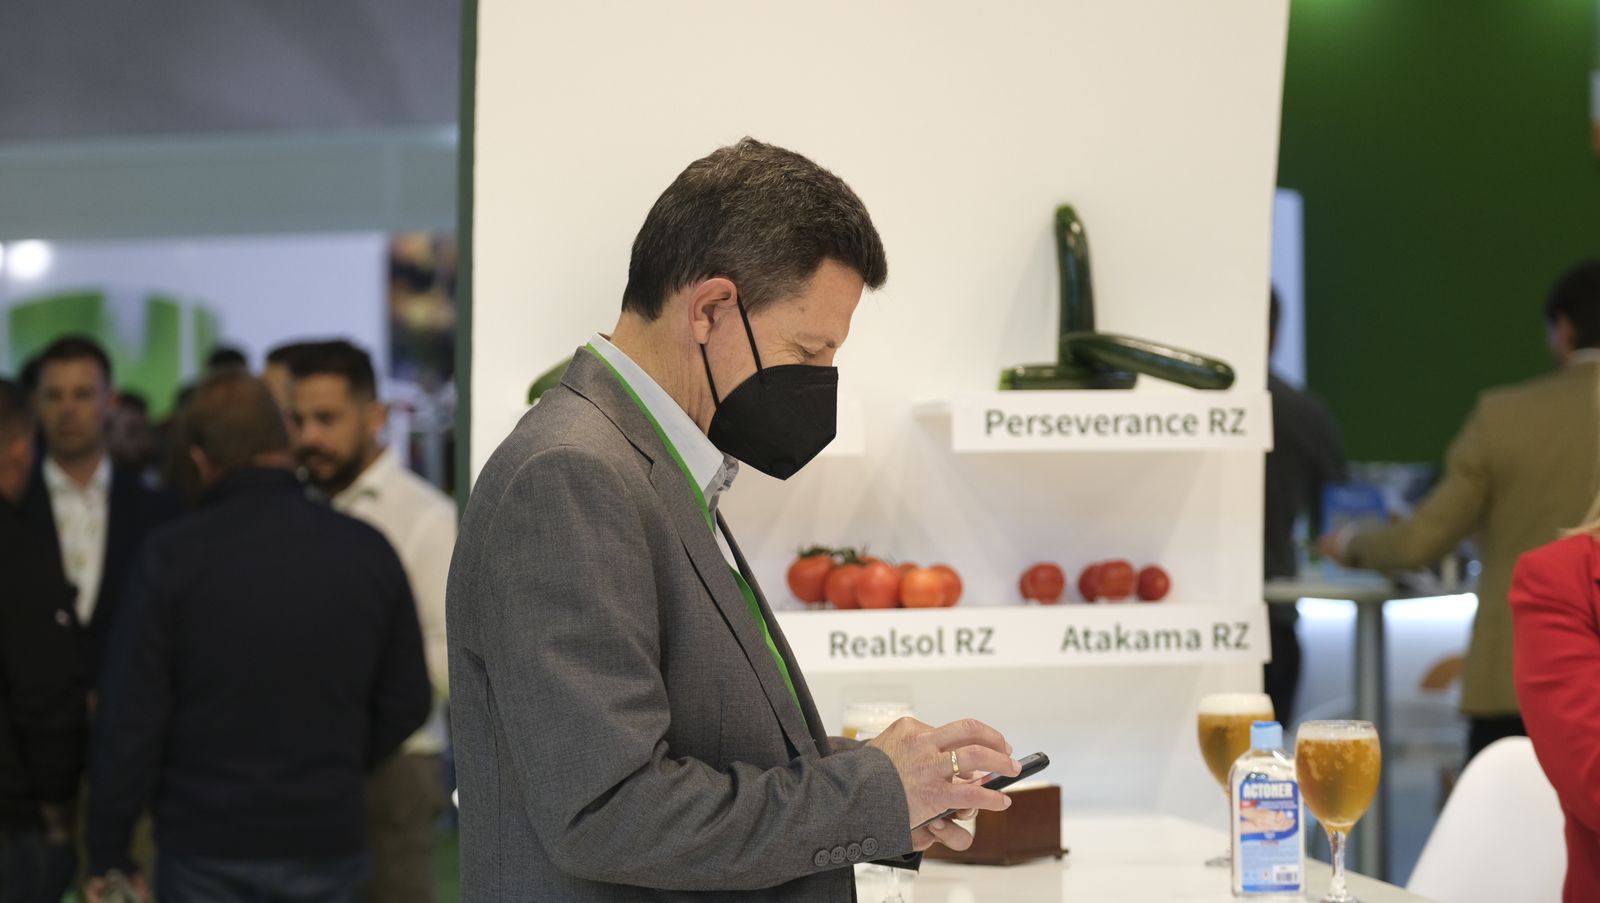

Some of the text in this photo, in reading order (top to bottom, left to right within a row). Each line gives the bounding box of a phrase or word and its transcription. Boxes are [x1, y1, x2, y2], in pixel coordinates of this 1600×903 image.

[984, 408, 1246, 436] Perseverance RZ
[829, 627, 995, 657] Realsol RZ
[1061, 622, 1250, 653] Atakama RZ
